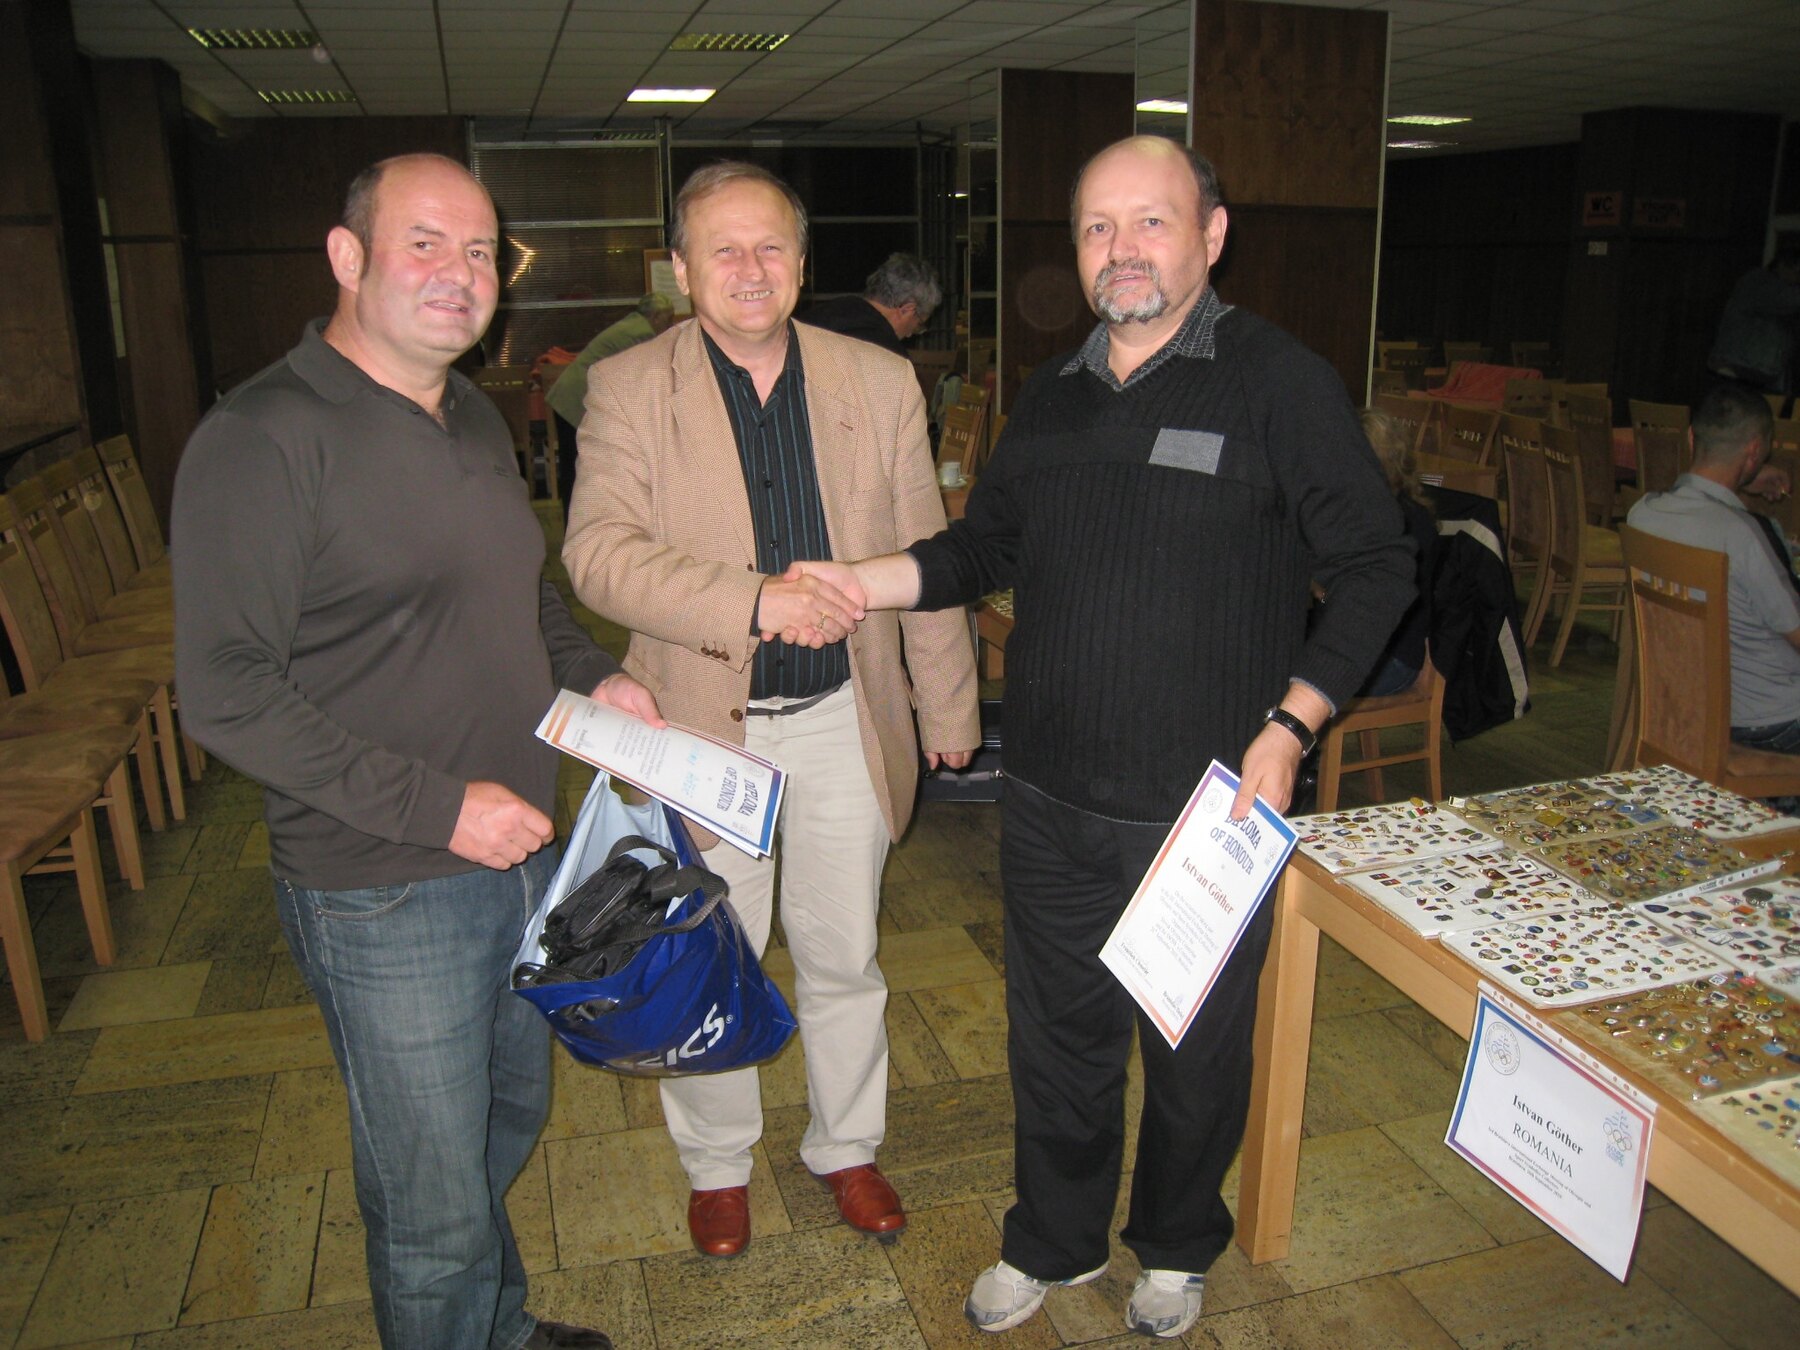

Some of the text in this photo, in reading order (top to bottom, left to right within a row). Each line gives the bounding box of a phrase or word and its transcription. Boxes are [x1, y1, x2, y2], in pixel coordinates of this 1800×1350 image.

[1591, 196, 1613, 212] WC
[717, 766, 738, 811] OF HONOUR
[737, 778, 759, 816] DIPLOMA
[1210, 827, 1254, 875] OF HONOUR
[1181, 857, 1234, 916] Istvan Göther
[1512, 1095, 1583, 1155] Istvan Göther
[1512, 1122, 1573, 1178] ROMANIA
